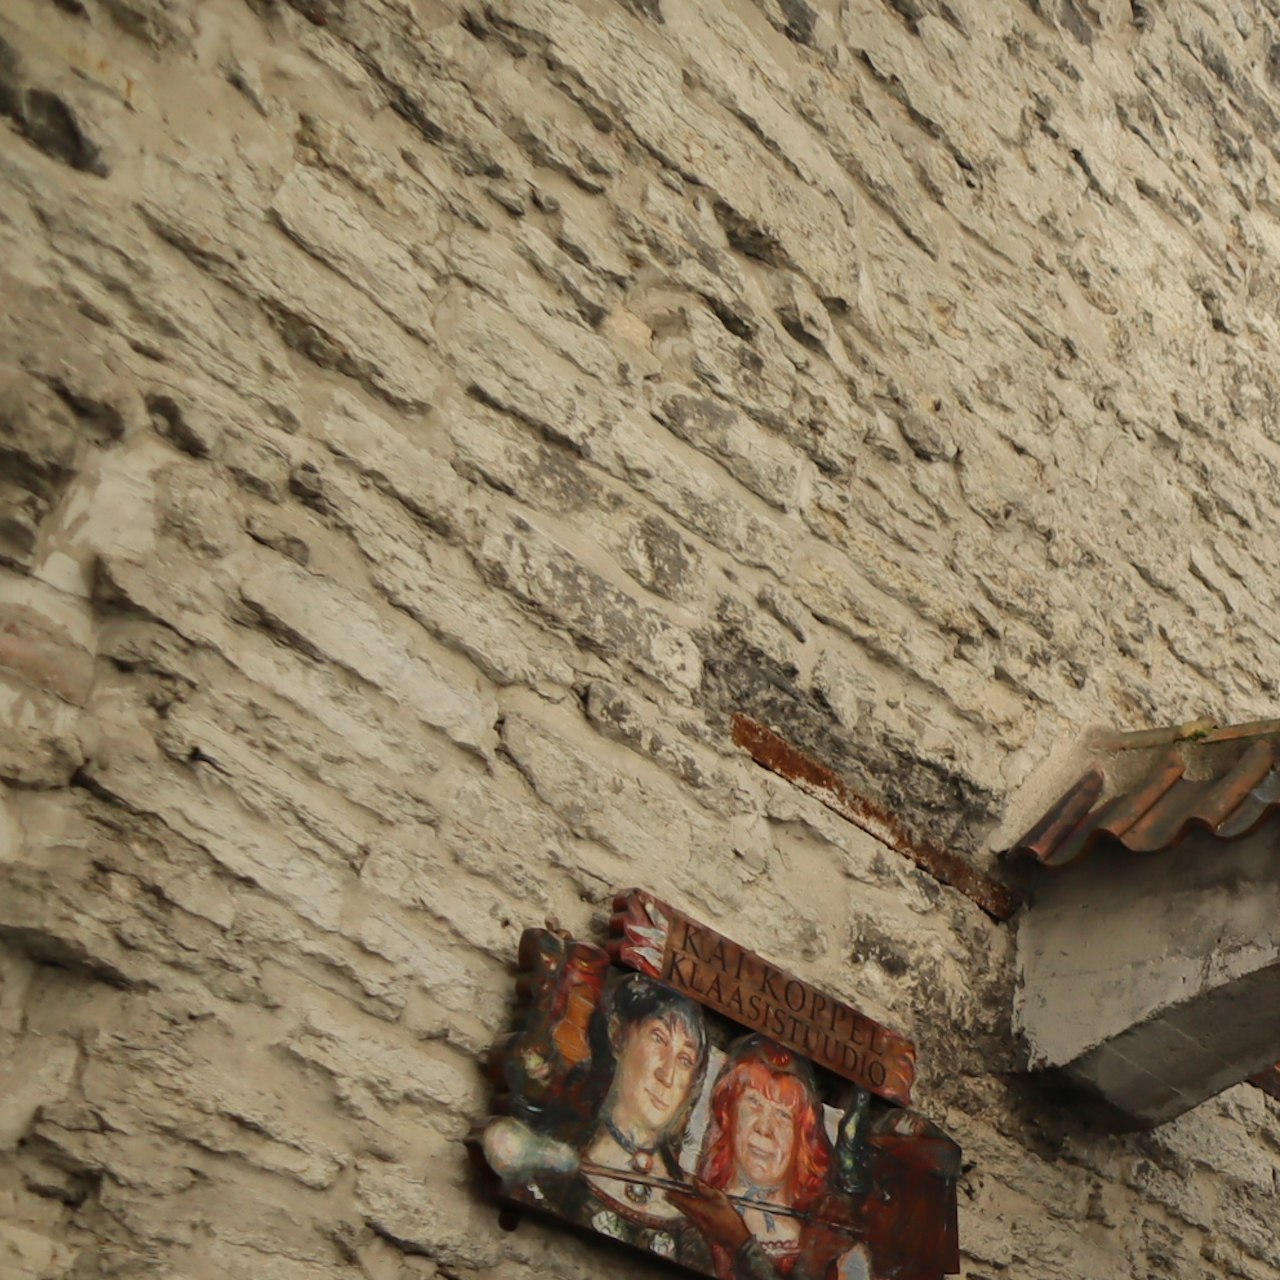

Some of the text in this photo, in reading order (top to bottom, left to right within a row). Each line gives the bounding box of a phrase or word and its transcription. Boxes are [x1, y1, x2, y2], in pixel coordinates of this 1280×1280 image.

[667, 951, 886, 1087] KLAASISTUUDIO
[682, 923, 884, 1057] KAI KOPPEL
